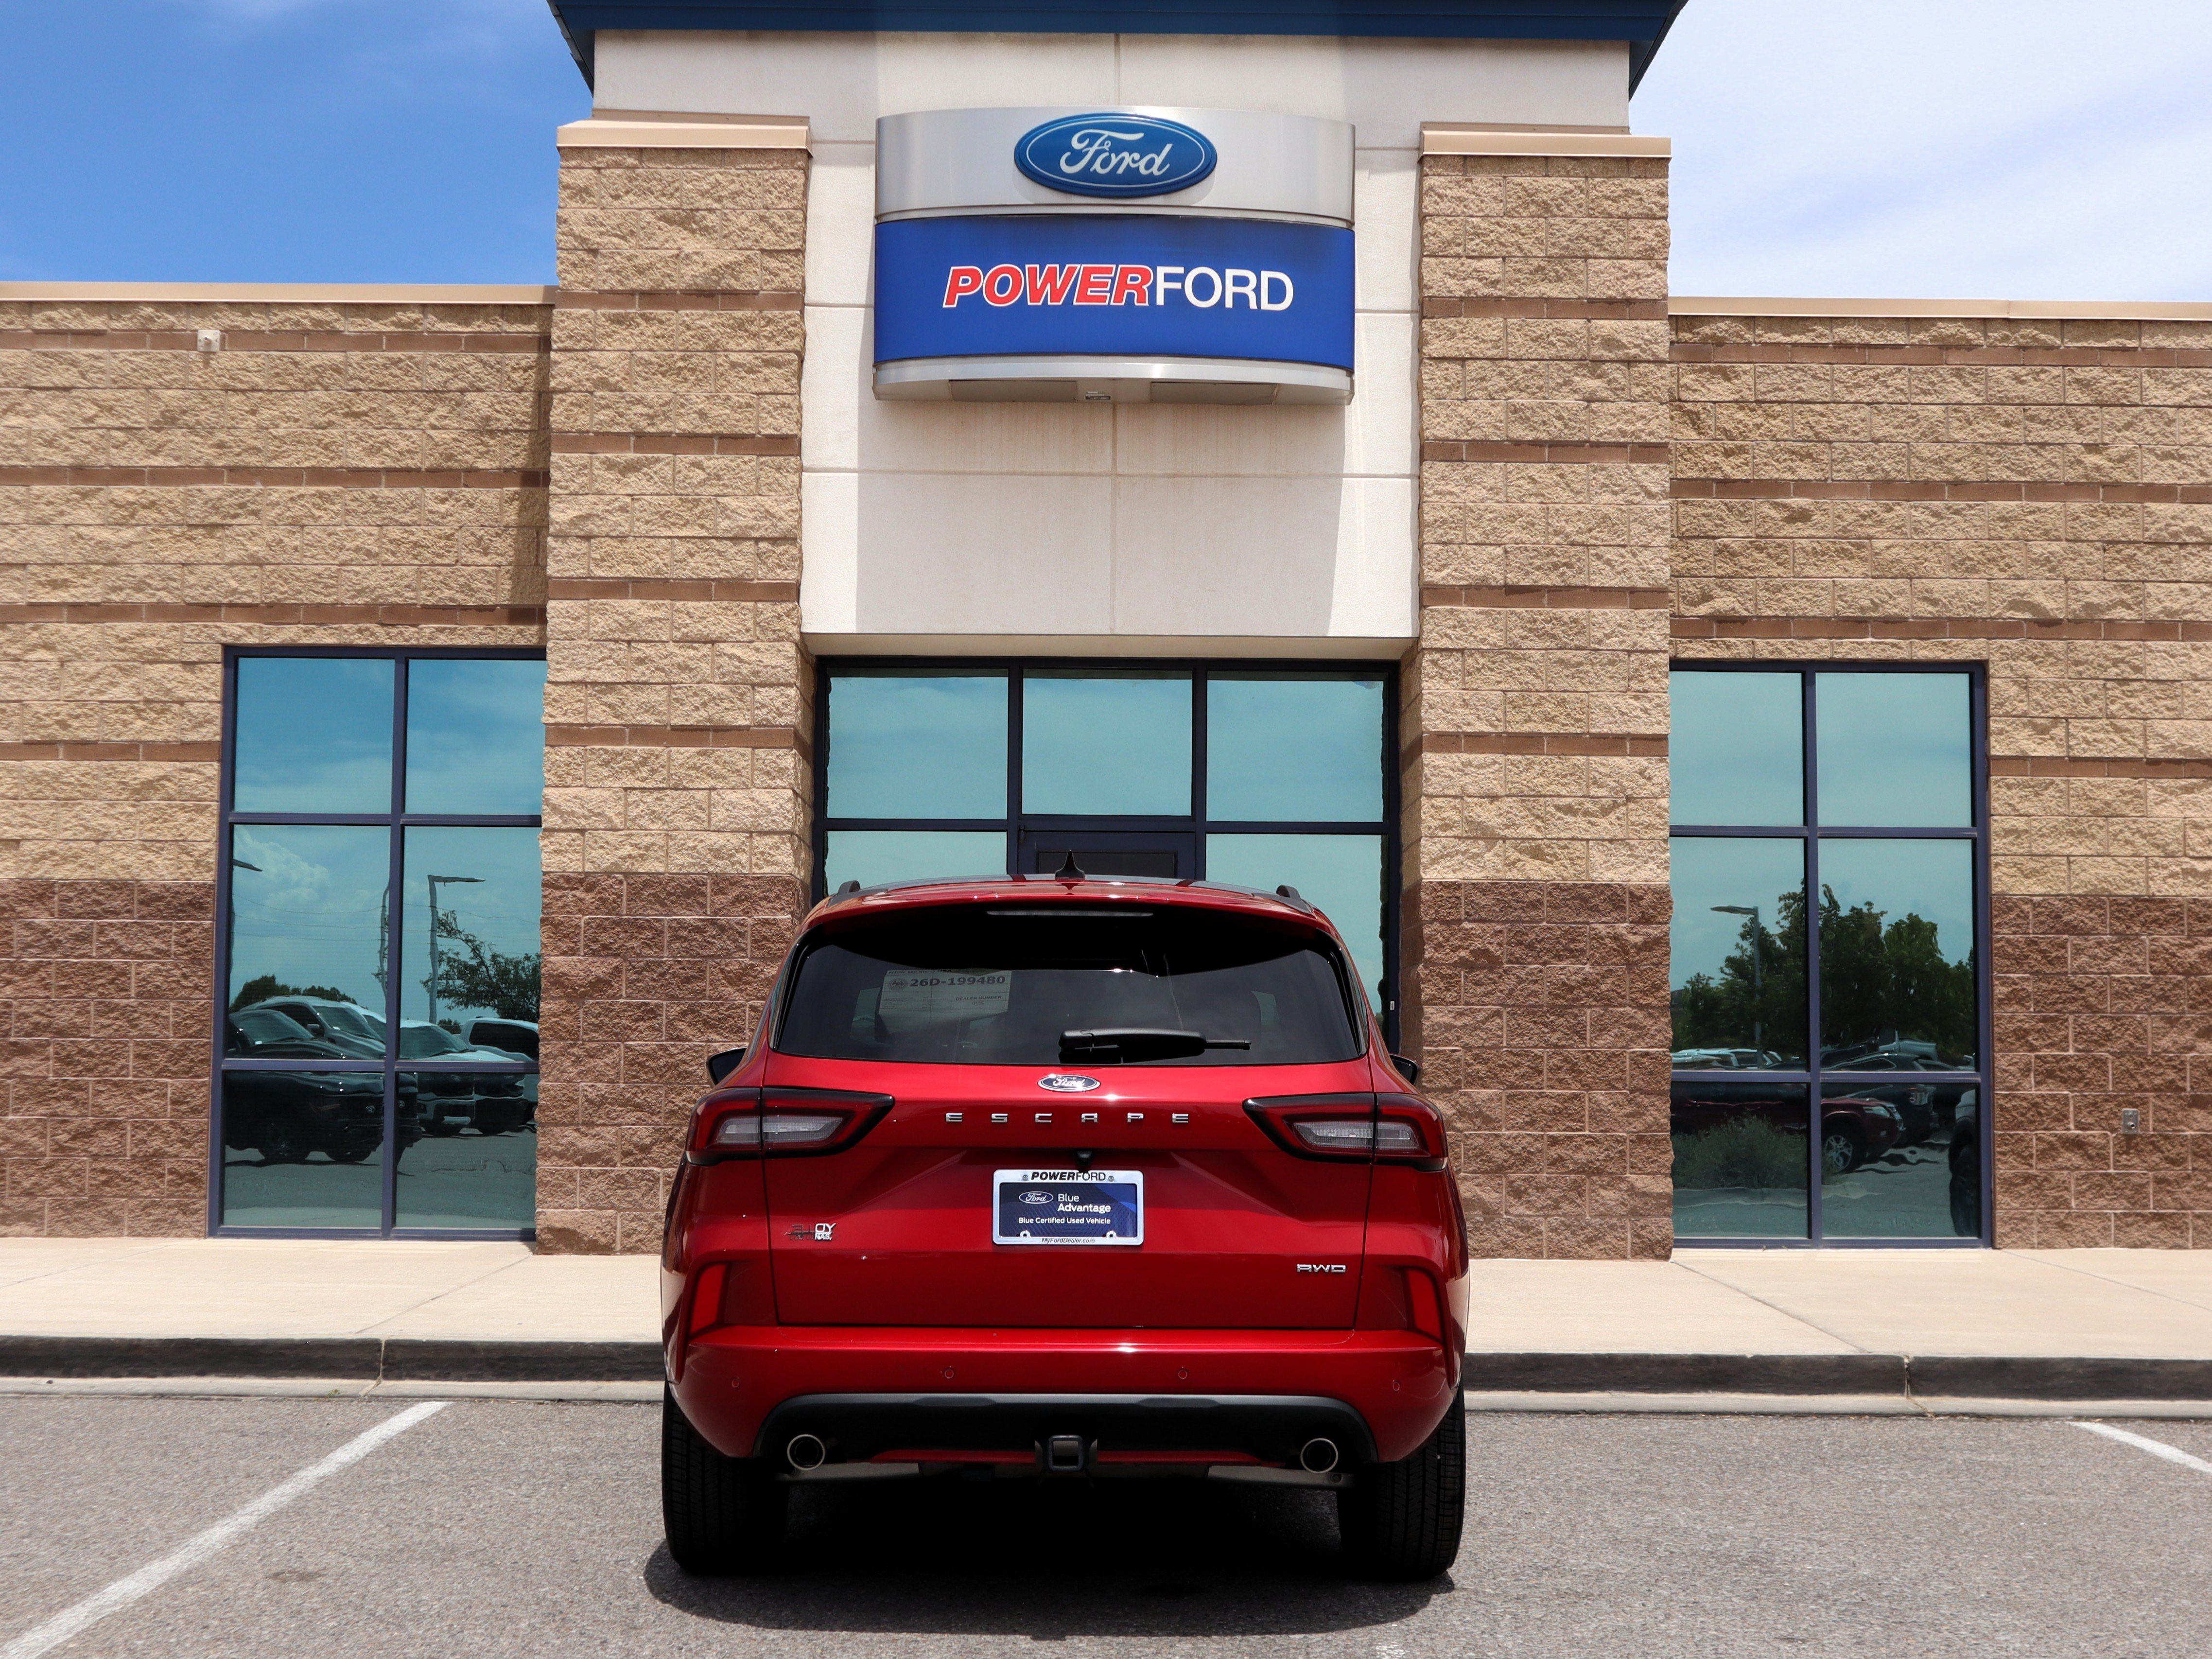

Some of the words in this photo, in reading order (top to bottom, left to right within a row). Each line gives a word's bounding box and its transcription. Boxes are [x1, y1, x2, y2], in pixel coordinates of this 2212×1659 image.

[1059, 128, 1173, 176] Ford
[942, 263, 1294, 312] POWERFORD
[909, 976, 1006, 987] 26D-199480
[1052, 1076, 1086, 1087] Ford
[945, 1112, 1189, 1123] ESCAPE
[1025, 1192, 1046, 1203] Ford
[1058, 1193, 1080, 1202] Blue
[1057, 1203, 1111, 1214] Advantage
[1297, 1263, 1346, 1273] AWD
